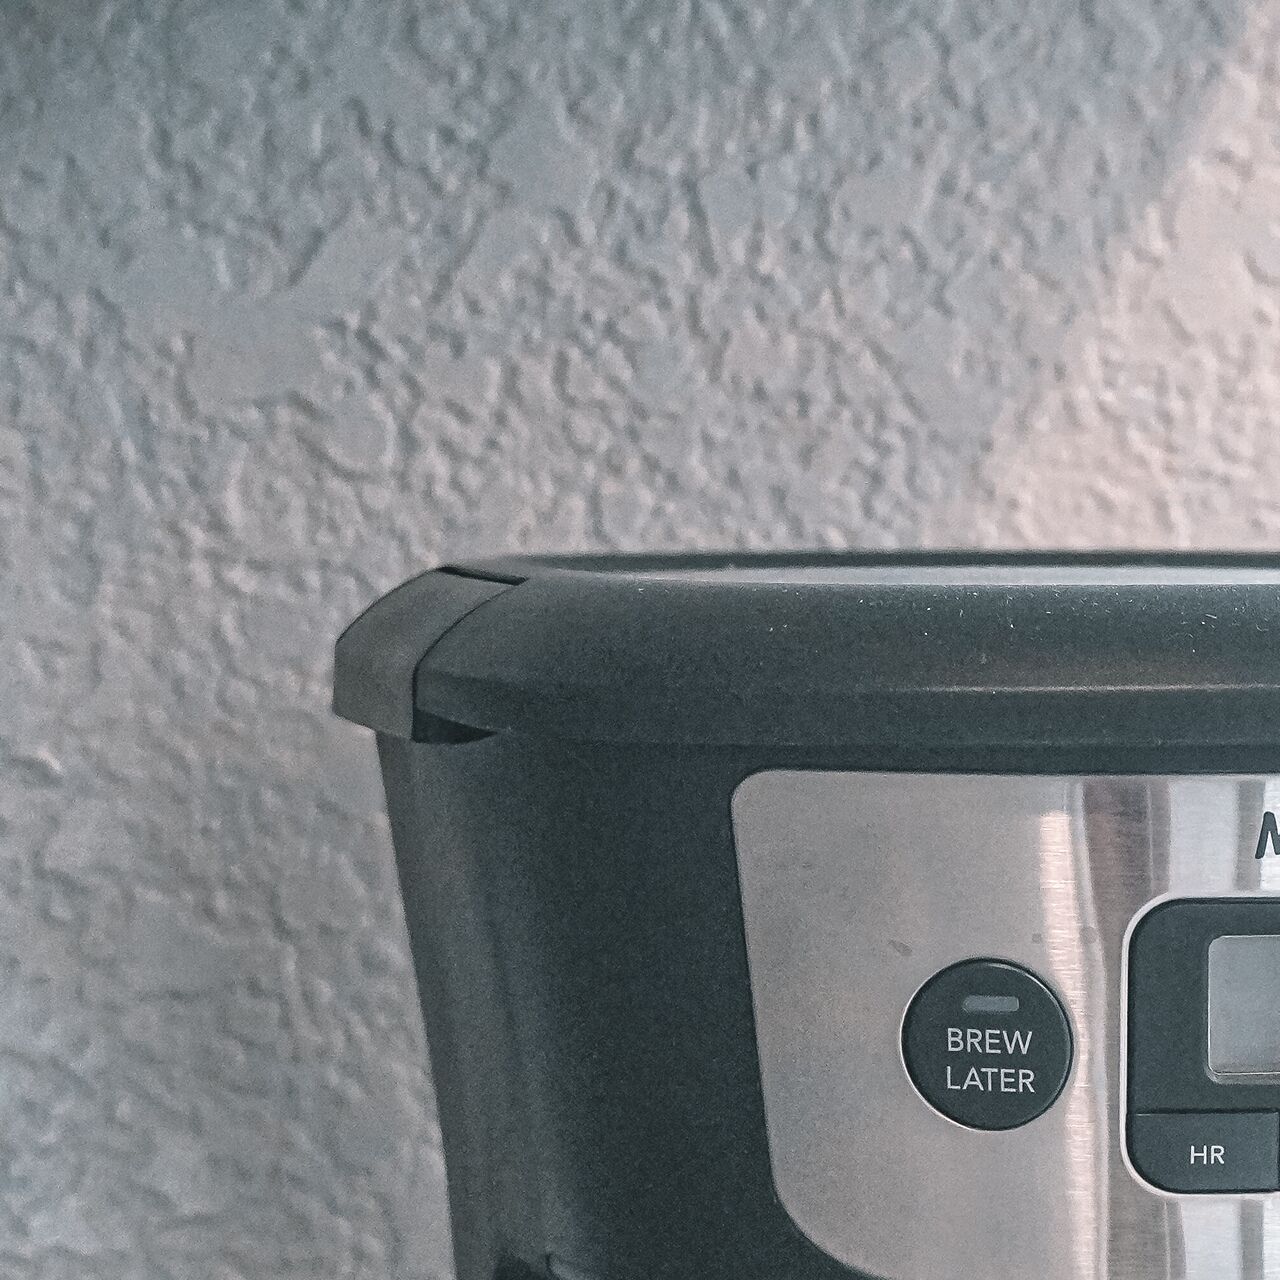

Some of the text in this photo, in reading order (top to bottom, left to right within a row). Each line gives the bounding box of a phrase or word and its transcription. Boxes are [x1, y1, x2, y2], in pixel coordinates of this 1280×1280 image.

[946, 1027, 1033, 1055] BREW
[945, 1065, 1036, 1094] LATER
[1189, 1145, 1226, 1166] HR
